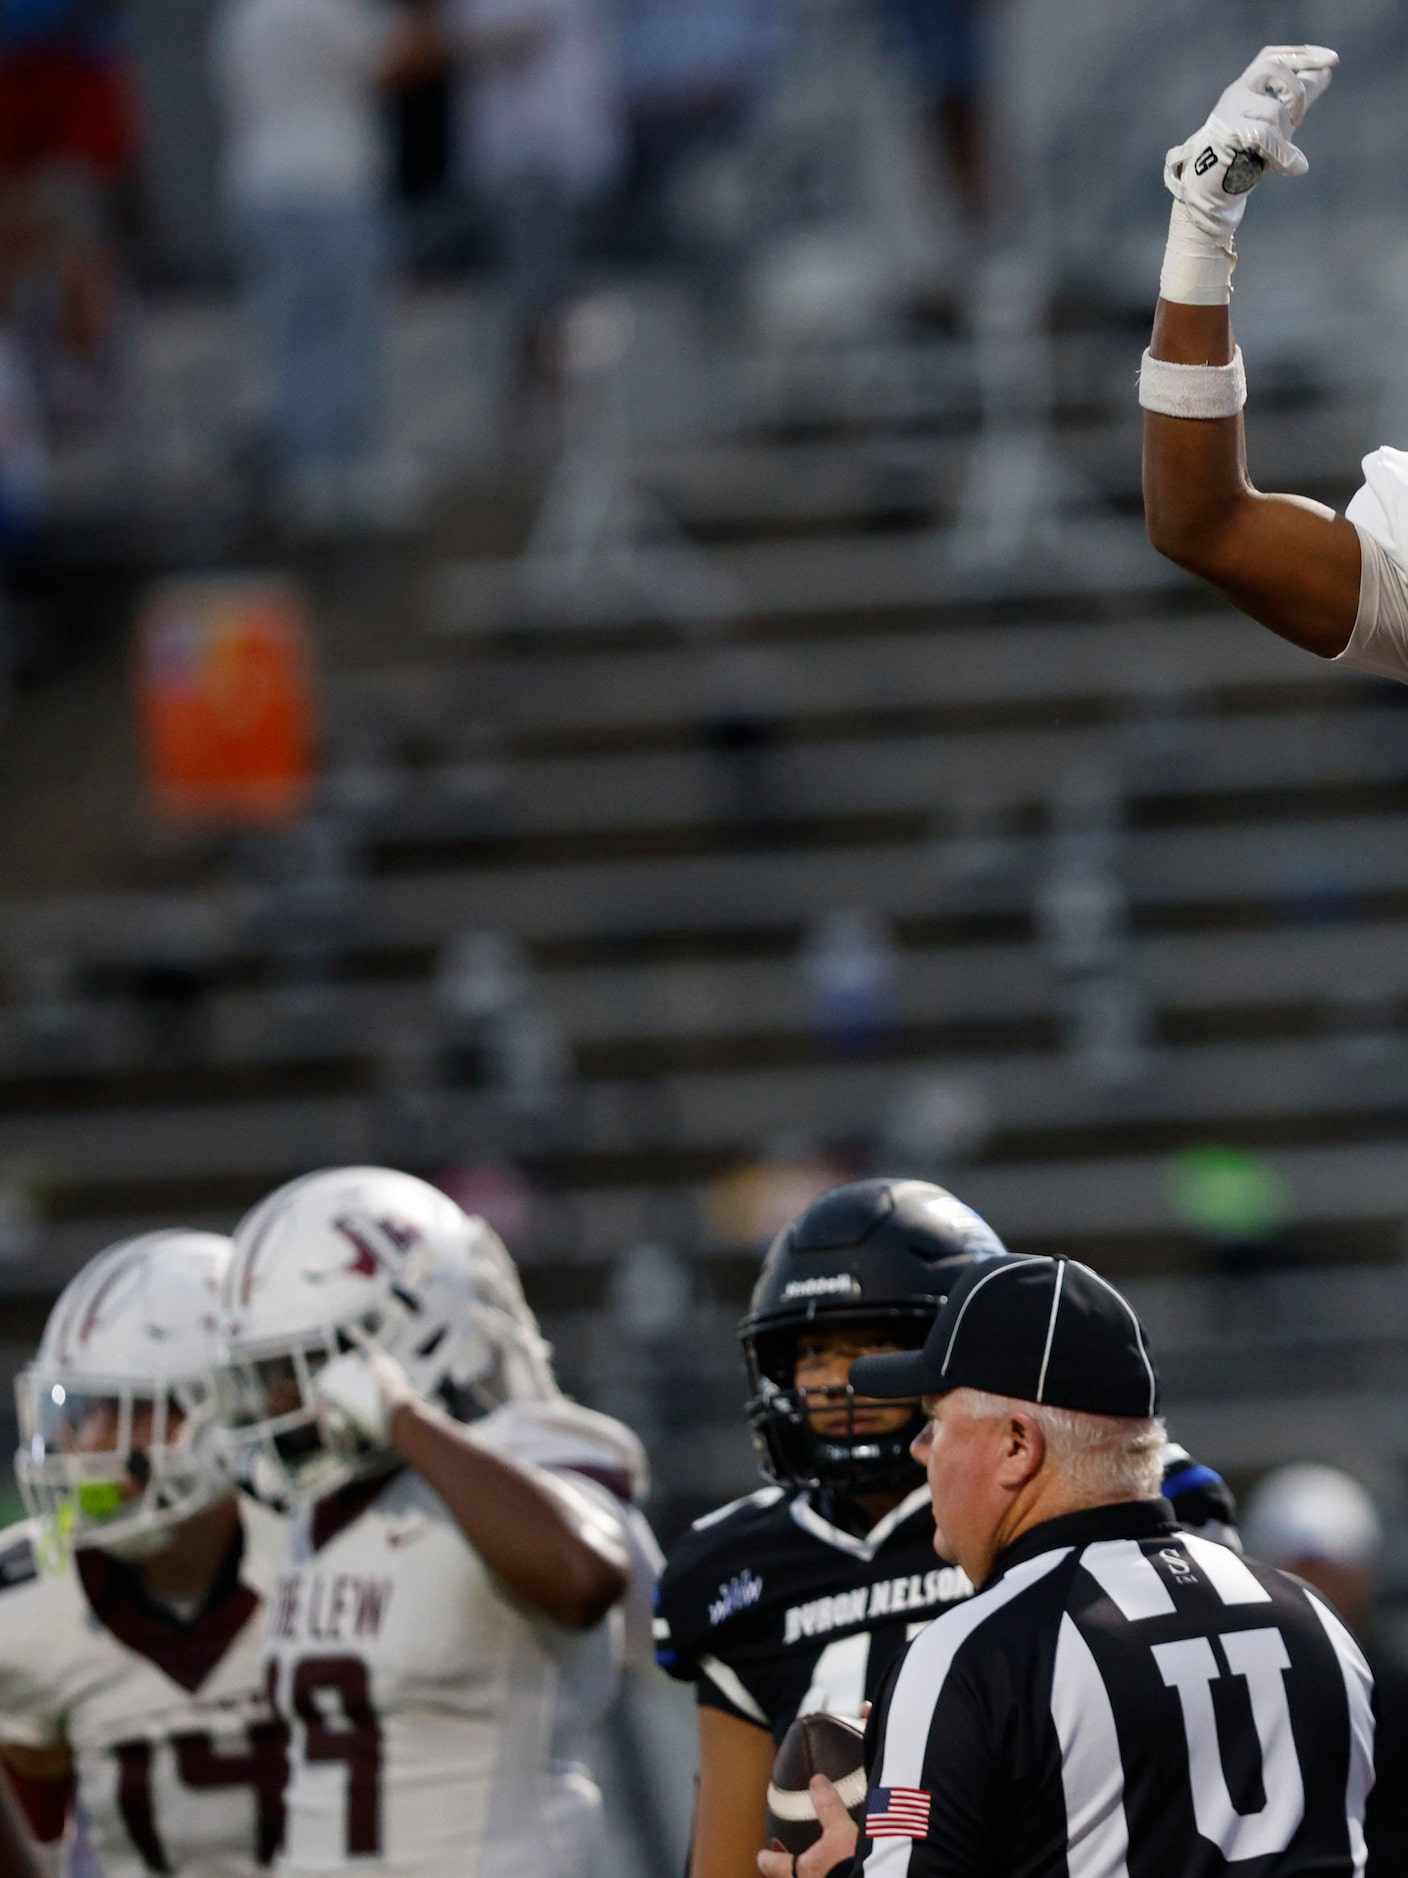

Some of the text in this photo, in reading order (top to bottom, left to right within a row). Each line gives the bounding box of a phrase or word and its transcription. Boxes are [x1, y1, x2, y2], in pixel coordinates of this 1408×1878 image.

[866, 1563, 974, 1620] NELSON
[108, 1714, 289, 1876] 14
[1150, 1626, 1305, 1863] U
